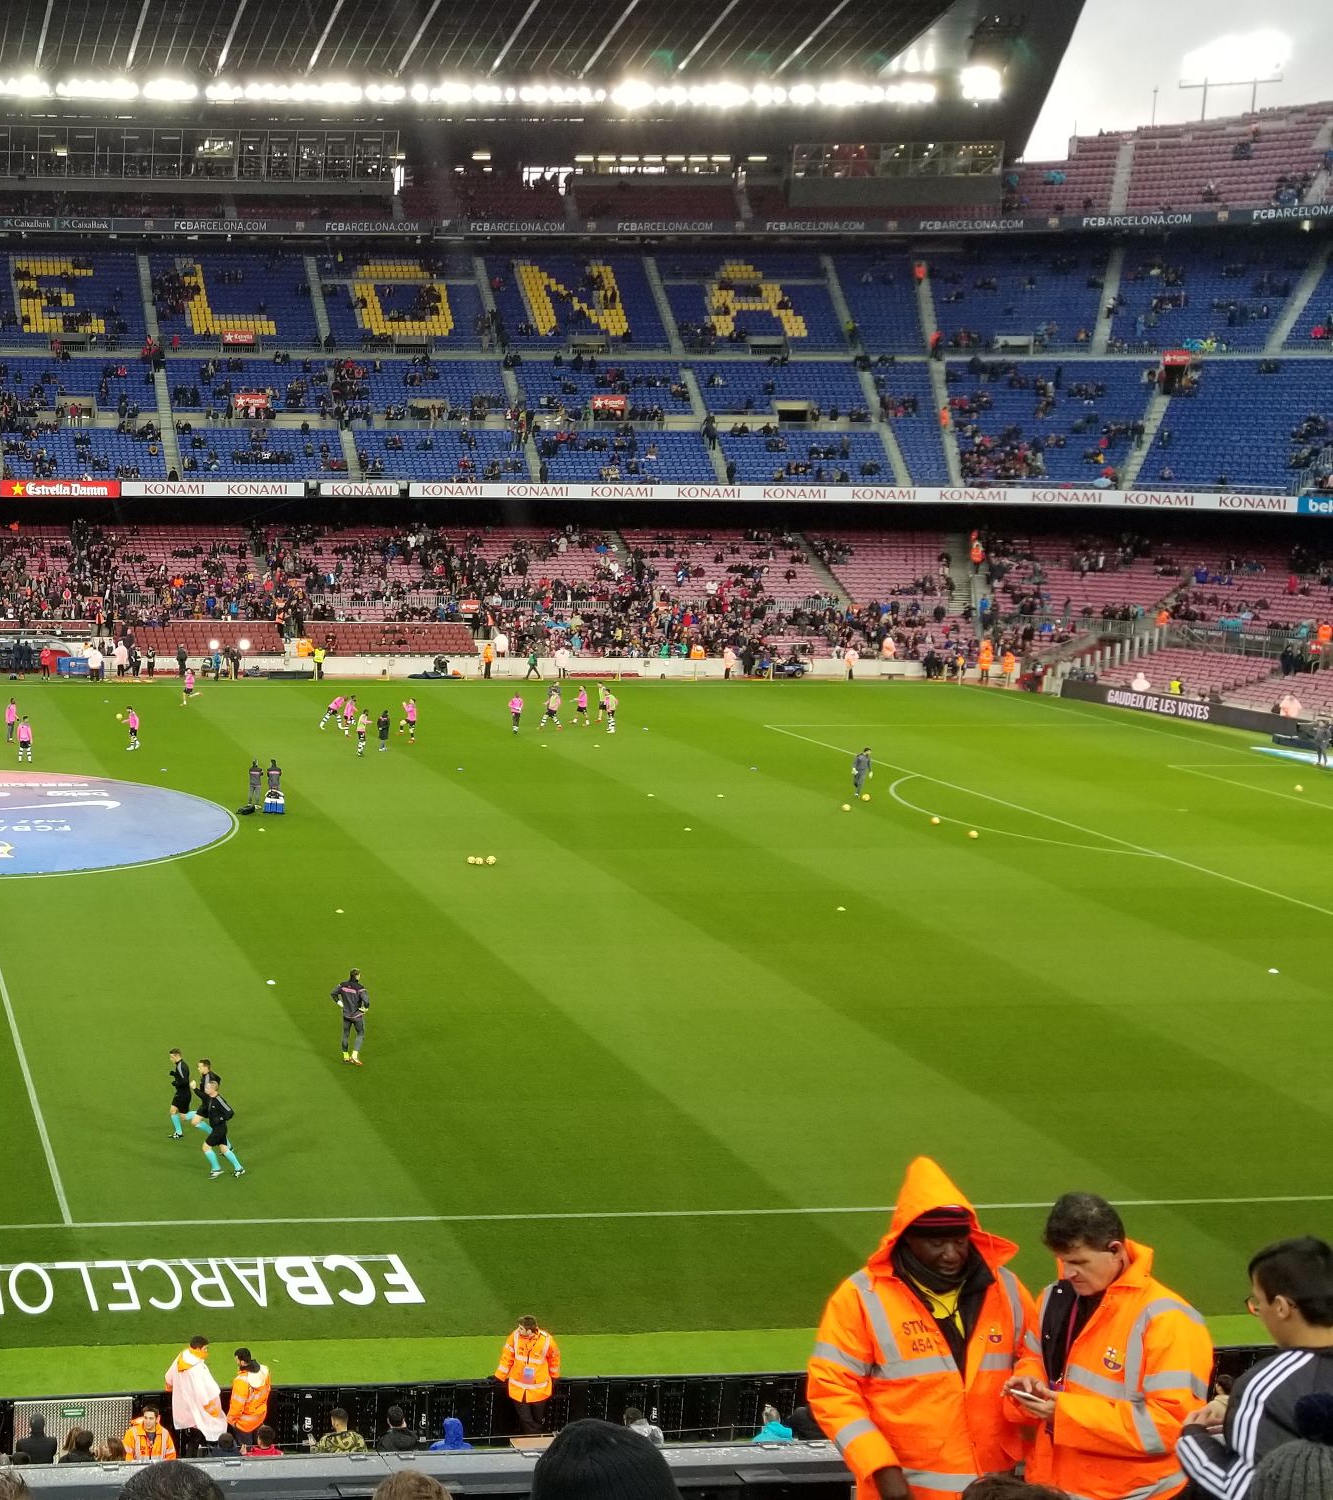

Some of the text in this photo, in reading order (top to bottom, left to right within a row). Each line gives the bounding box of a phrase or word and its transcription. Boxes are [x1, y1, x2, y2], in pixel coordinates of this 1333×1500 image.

[14, 218, 51, 229] CaixaBank
[71, 219, 109, 229] CaixaBank
[174, 221, 267, 231] FCBARCELONA.COM
[766, 221, 865, 231] FCBARCELONA.COM
[919, 219, 1024, 230] FCBARCELONA.COM
[1082, 213, 1192, 228] FCBARCELONA.COM
[325, 221, 418, 232] FCBARCELONA.COM
[470, 222, 565, 232] FCBARCELONA.COM
[617, 222, 713, 232] FCBARCELONA.COM
[26, 482, 109, 496] Estrella Damm
[143, 482, 206, 494] KONAMI
[227, 484, 289, 494] KONAMI
[332, 485, 393, 496] KONAMI
[421, 485, 483, 496] KONAMI
[507, 486, 569, 497] KONAMI
[590, 487, 654, 497] KONAMI
[677, 487, 741, 498] KONAMI
[763, 488, 827, 499] KONAMI
[851, 489, 916, 500] KONAMI
[939, 491, 1007, 502] KONAMI
[1031, 491, 1102, 503] KONAMI
[1124, 493, 1195, 506] KONAMI
[1218, 496, 1287, 510] KONAMI
[1107, 689, 1210, 720] GAUDEIX DE LES VISTES
[911, 1337, 934, 1354] 454
